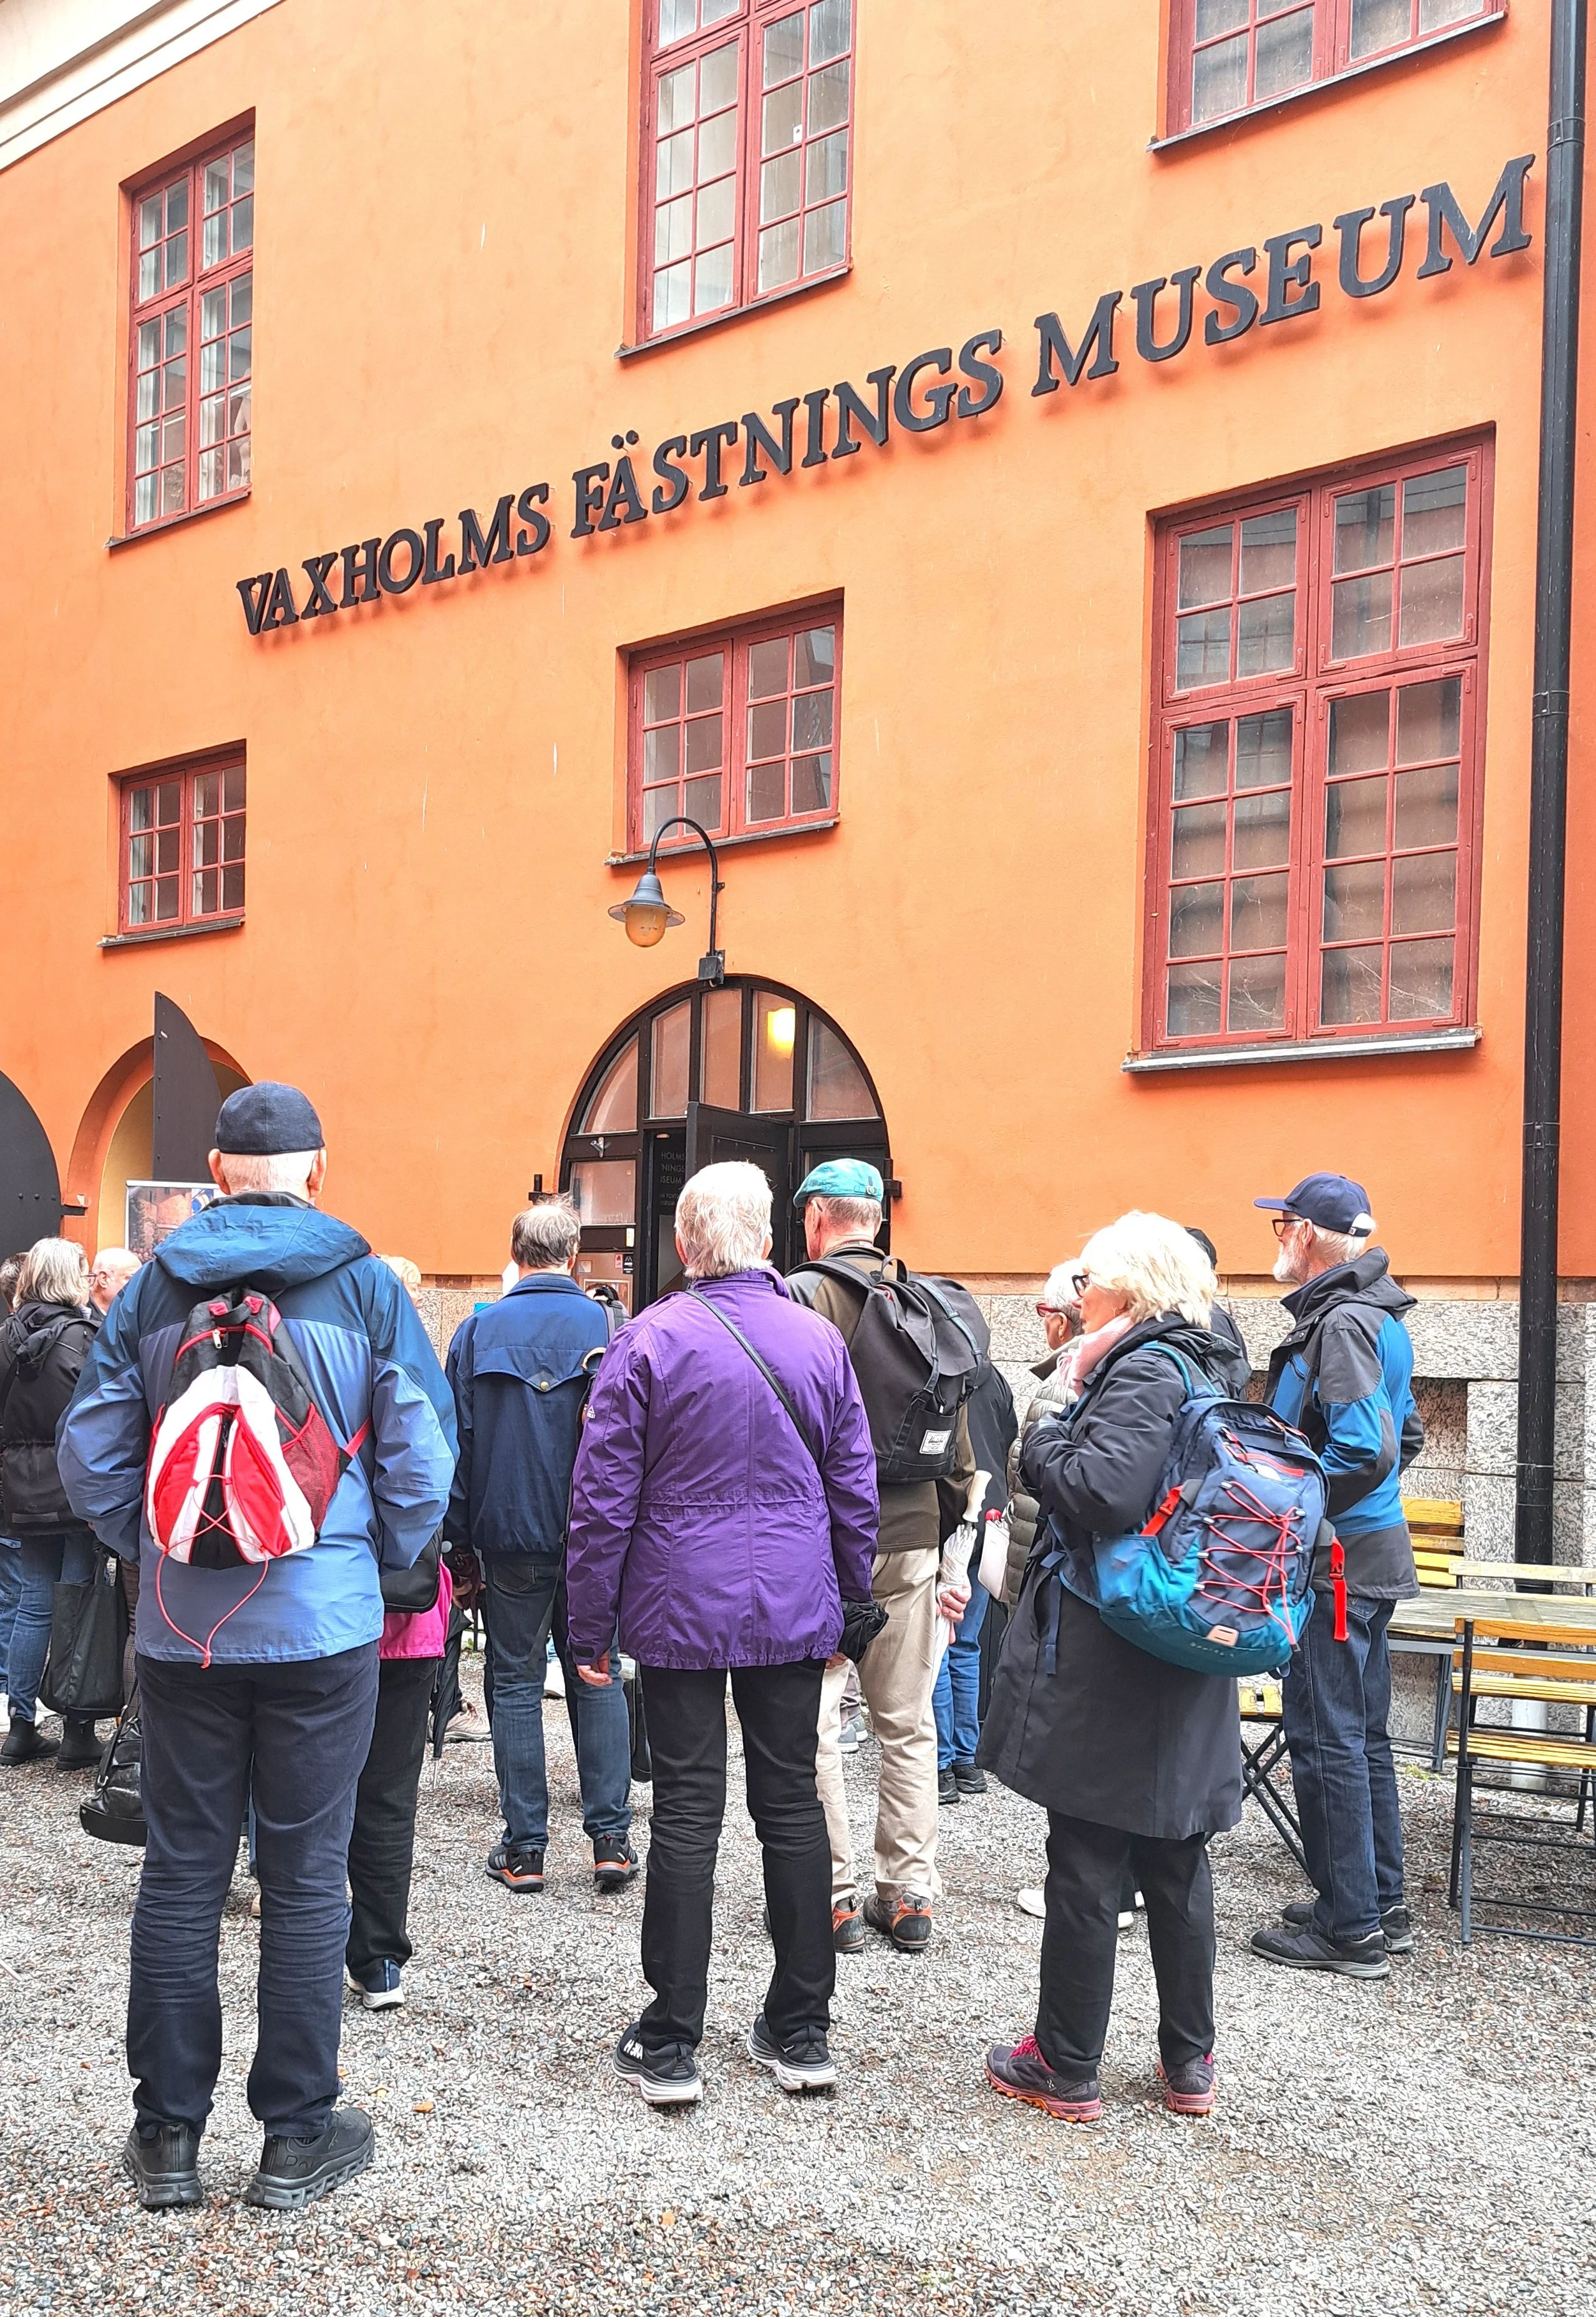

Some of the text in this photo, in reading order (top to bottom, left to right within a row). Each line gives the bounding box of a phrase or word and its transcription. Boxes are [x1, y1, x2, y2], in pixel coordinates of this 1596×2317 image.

[236, 153, 1536, 636] VAXHOLMS FÄSTNINGS MUSEUM
